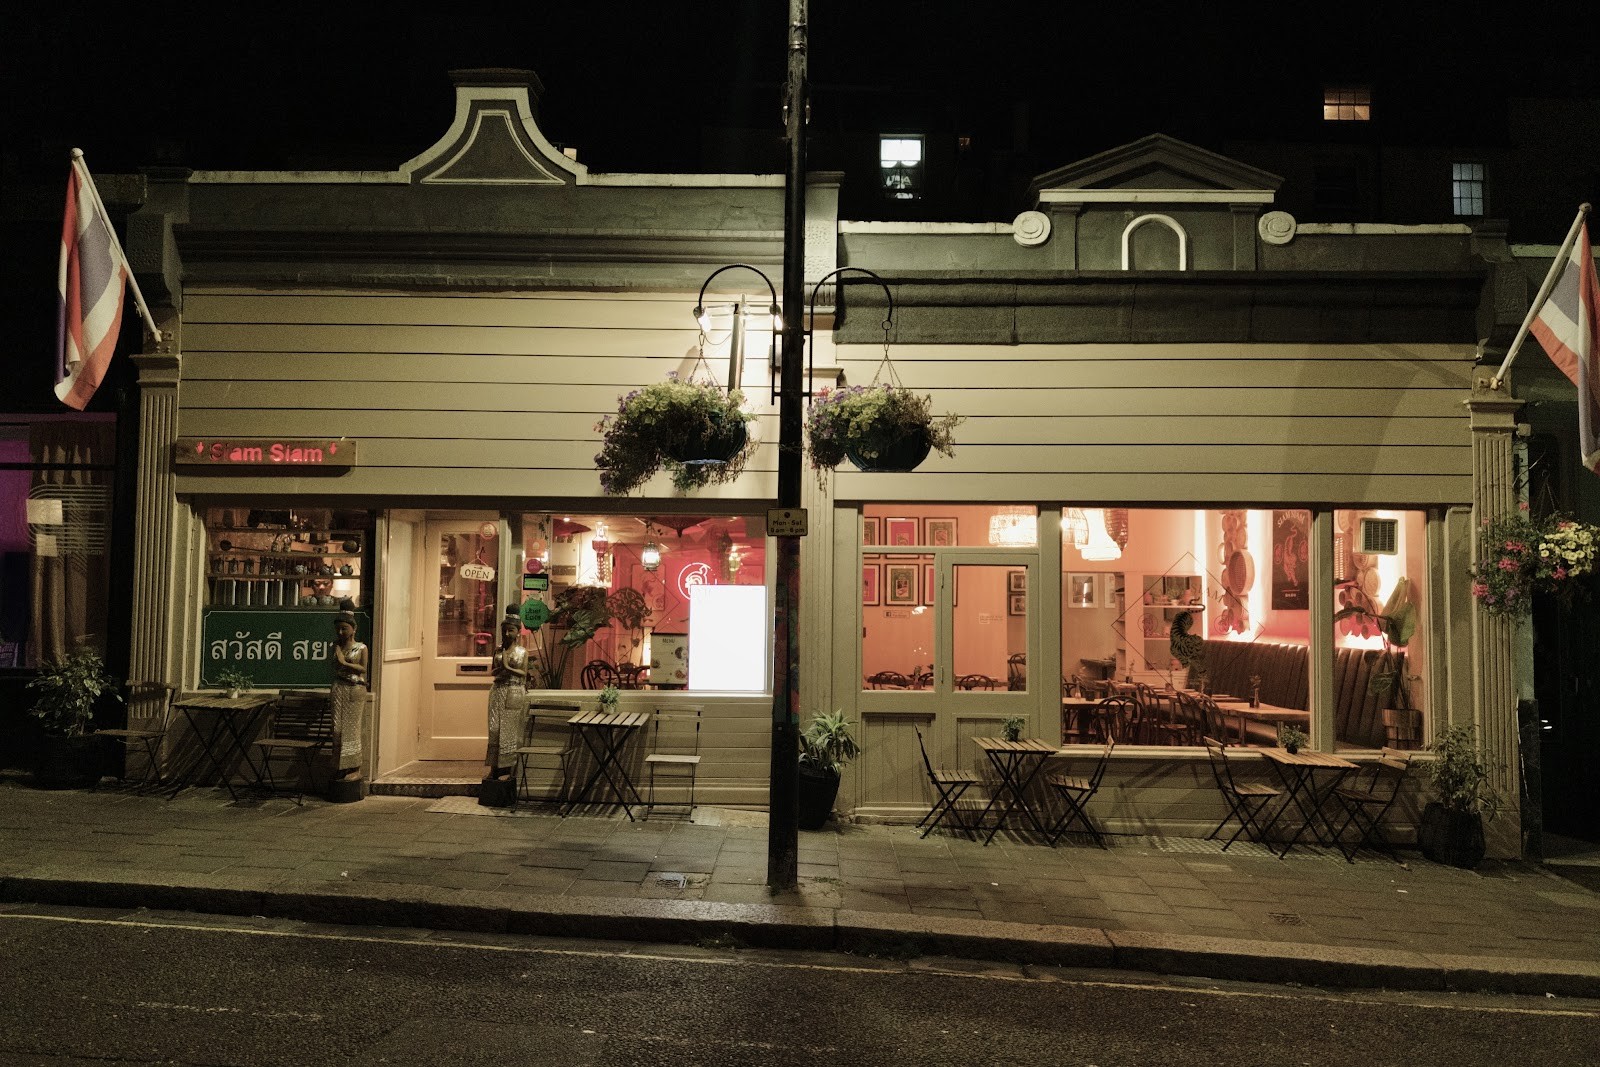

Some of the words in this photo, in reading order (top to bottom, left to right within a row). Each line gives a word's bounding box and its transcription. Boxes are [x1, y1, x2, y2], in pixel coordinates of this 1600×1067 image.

[209, 443, 263, 461] Siam
[269, 443, 323, 462] Siam
[464, 568, 490, 580] OPEN
[210, 631, 282, 661] สวัสดี
[292, 639, 335, 661] สย
